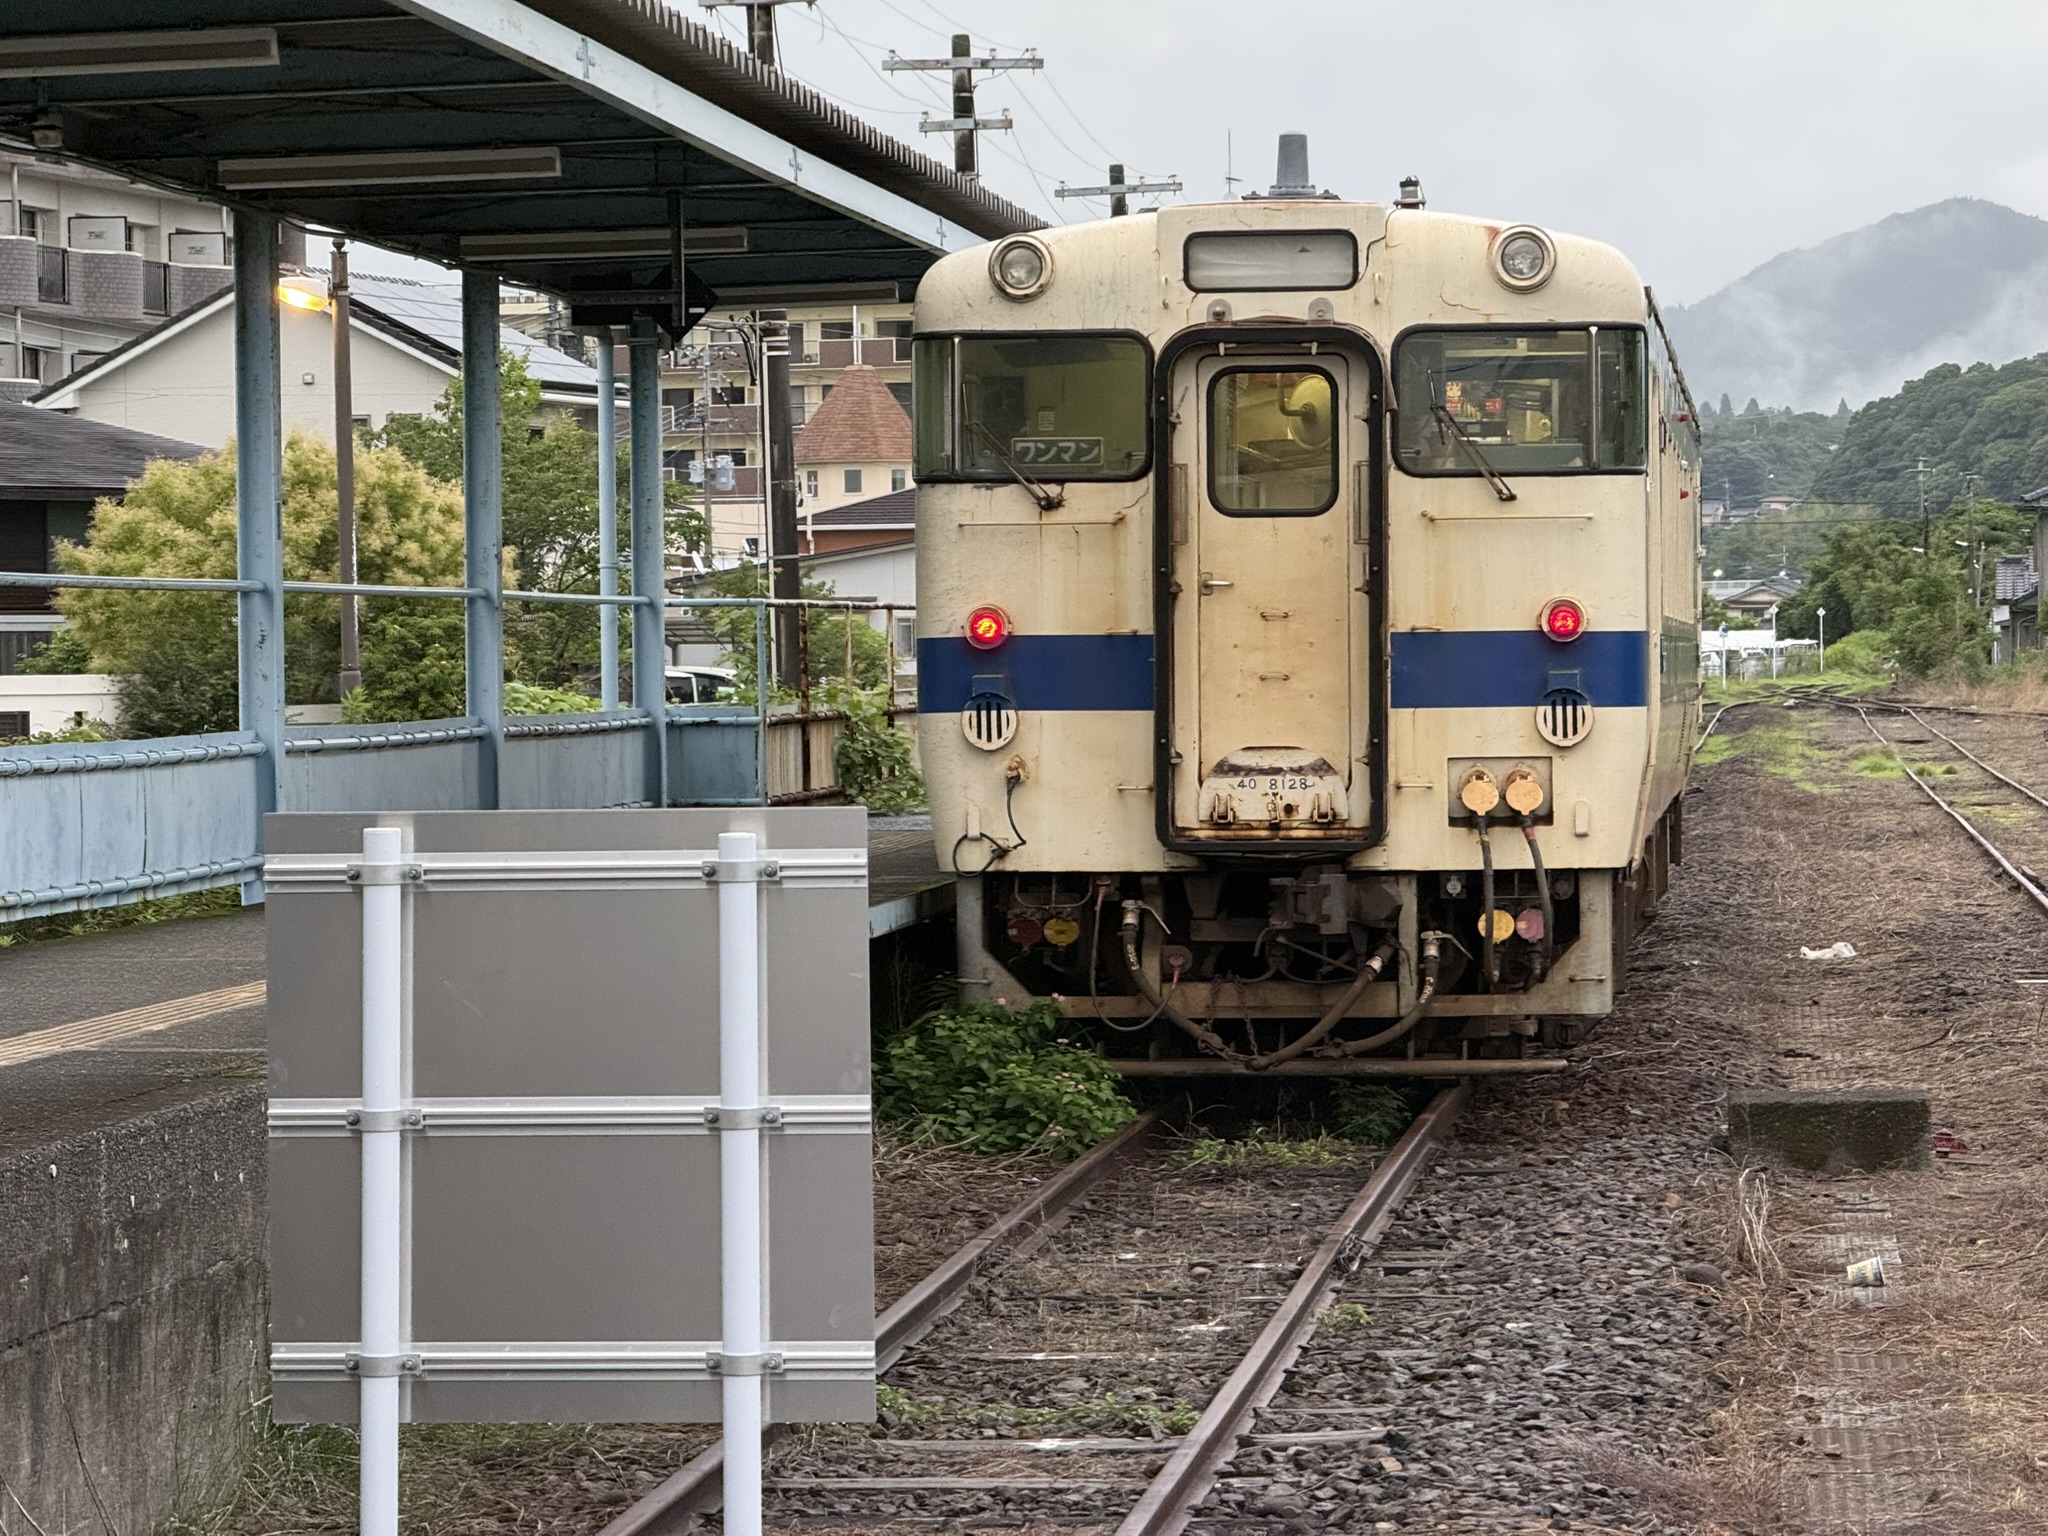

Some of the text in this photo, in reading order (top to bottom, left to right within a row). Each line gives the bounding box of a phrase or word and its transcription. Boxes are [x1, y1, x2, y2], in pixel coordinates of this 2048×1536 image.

[1015, 442, 1100, 462] ワンマン
[1236, 778, 1308, 790] 40 8128
